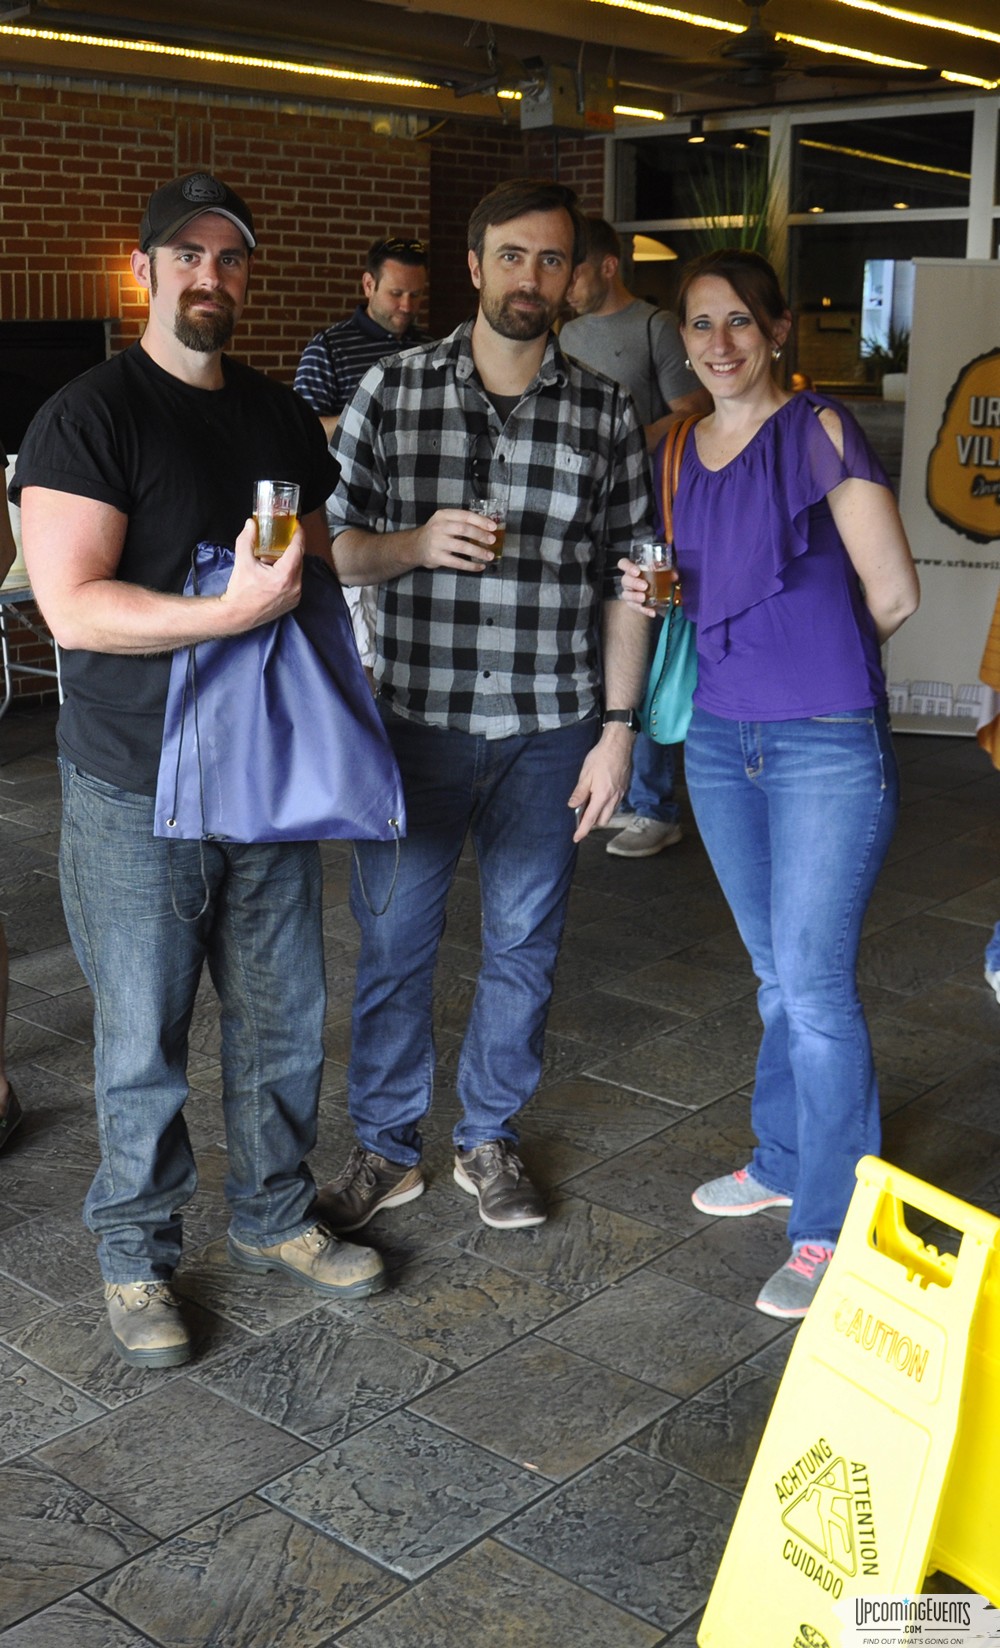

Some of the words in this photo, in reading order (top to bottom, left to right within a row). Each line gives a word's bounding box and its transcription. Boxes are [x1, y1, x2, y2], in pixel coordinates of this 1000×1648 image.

[834, 1298, 929, 1383] CAUTION
[775, 1438, 832, 1504] ACHTUNG
[851, 1461, 879, 1575] ATTENTION
[783, 1539, 843, 1599] CUIDADO
